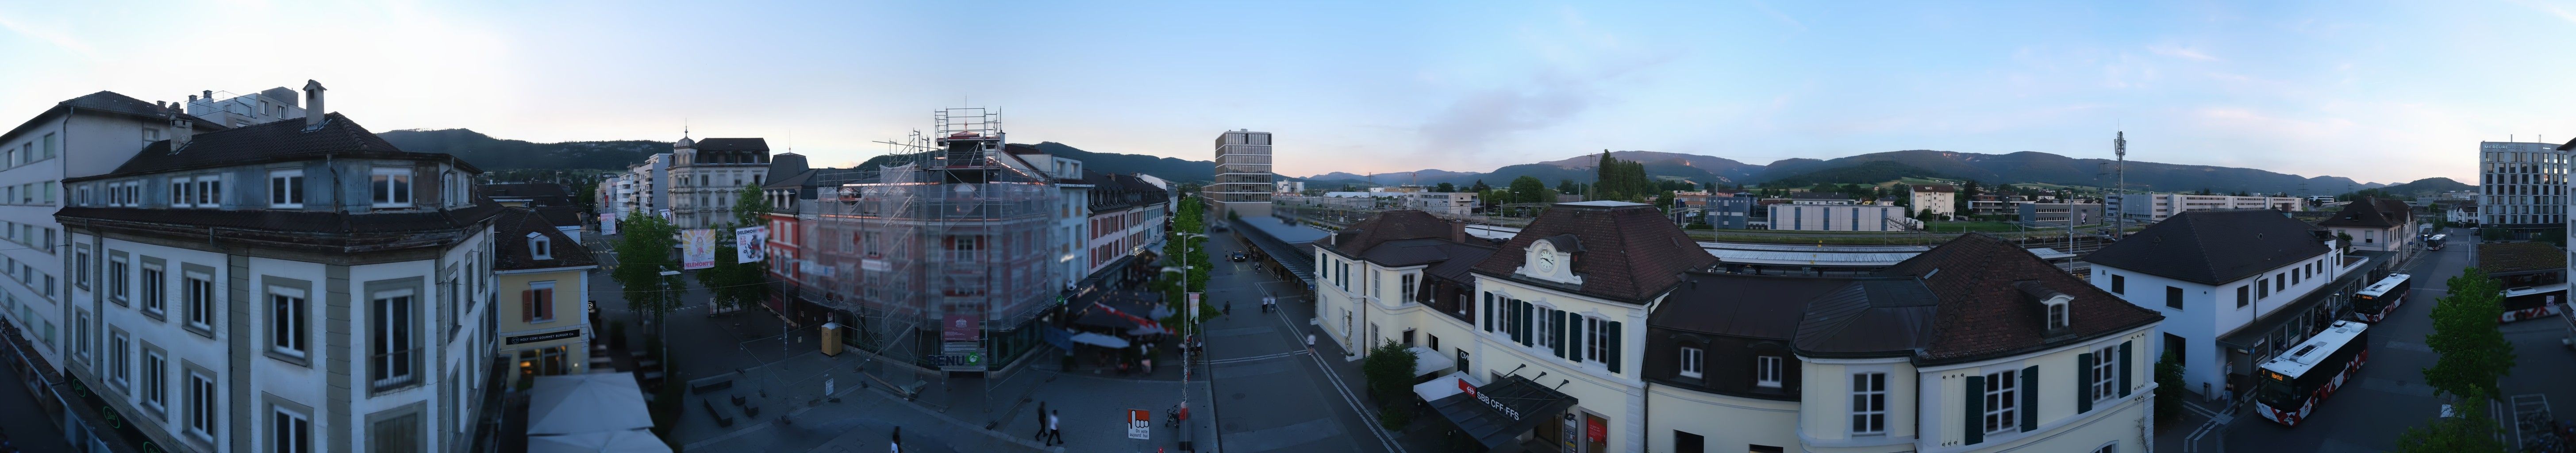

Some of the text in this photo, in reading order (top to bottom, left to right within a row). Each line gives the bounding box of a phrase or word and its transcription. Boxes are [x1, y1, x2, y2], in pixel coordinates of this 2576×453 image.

[928, 355, 965, 366] BENU
[1477, 392, 1519, 421] SBB CFF FFS
